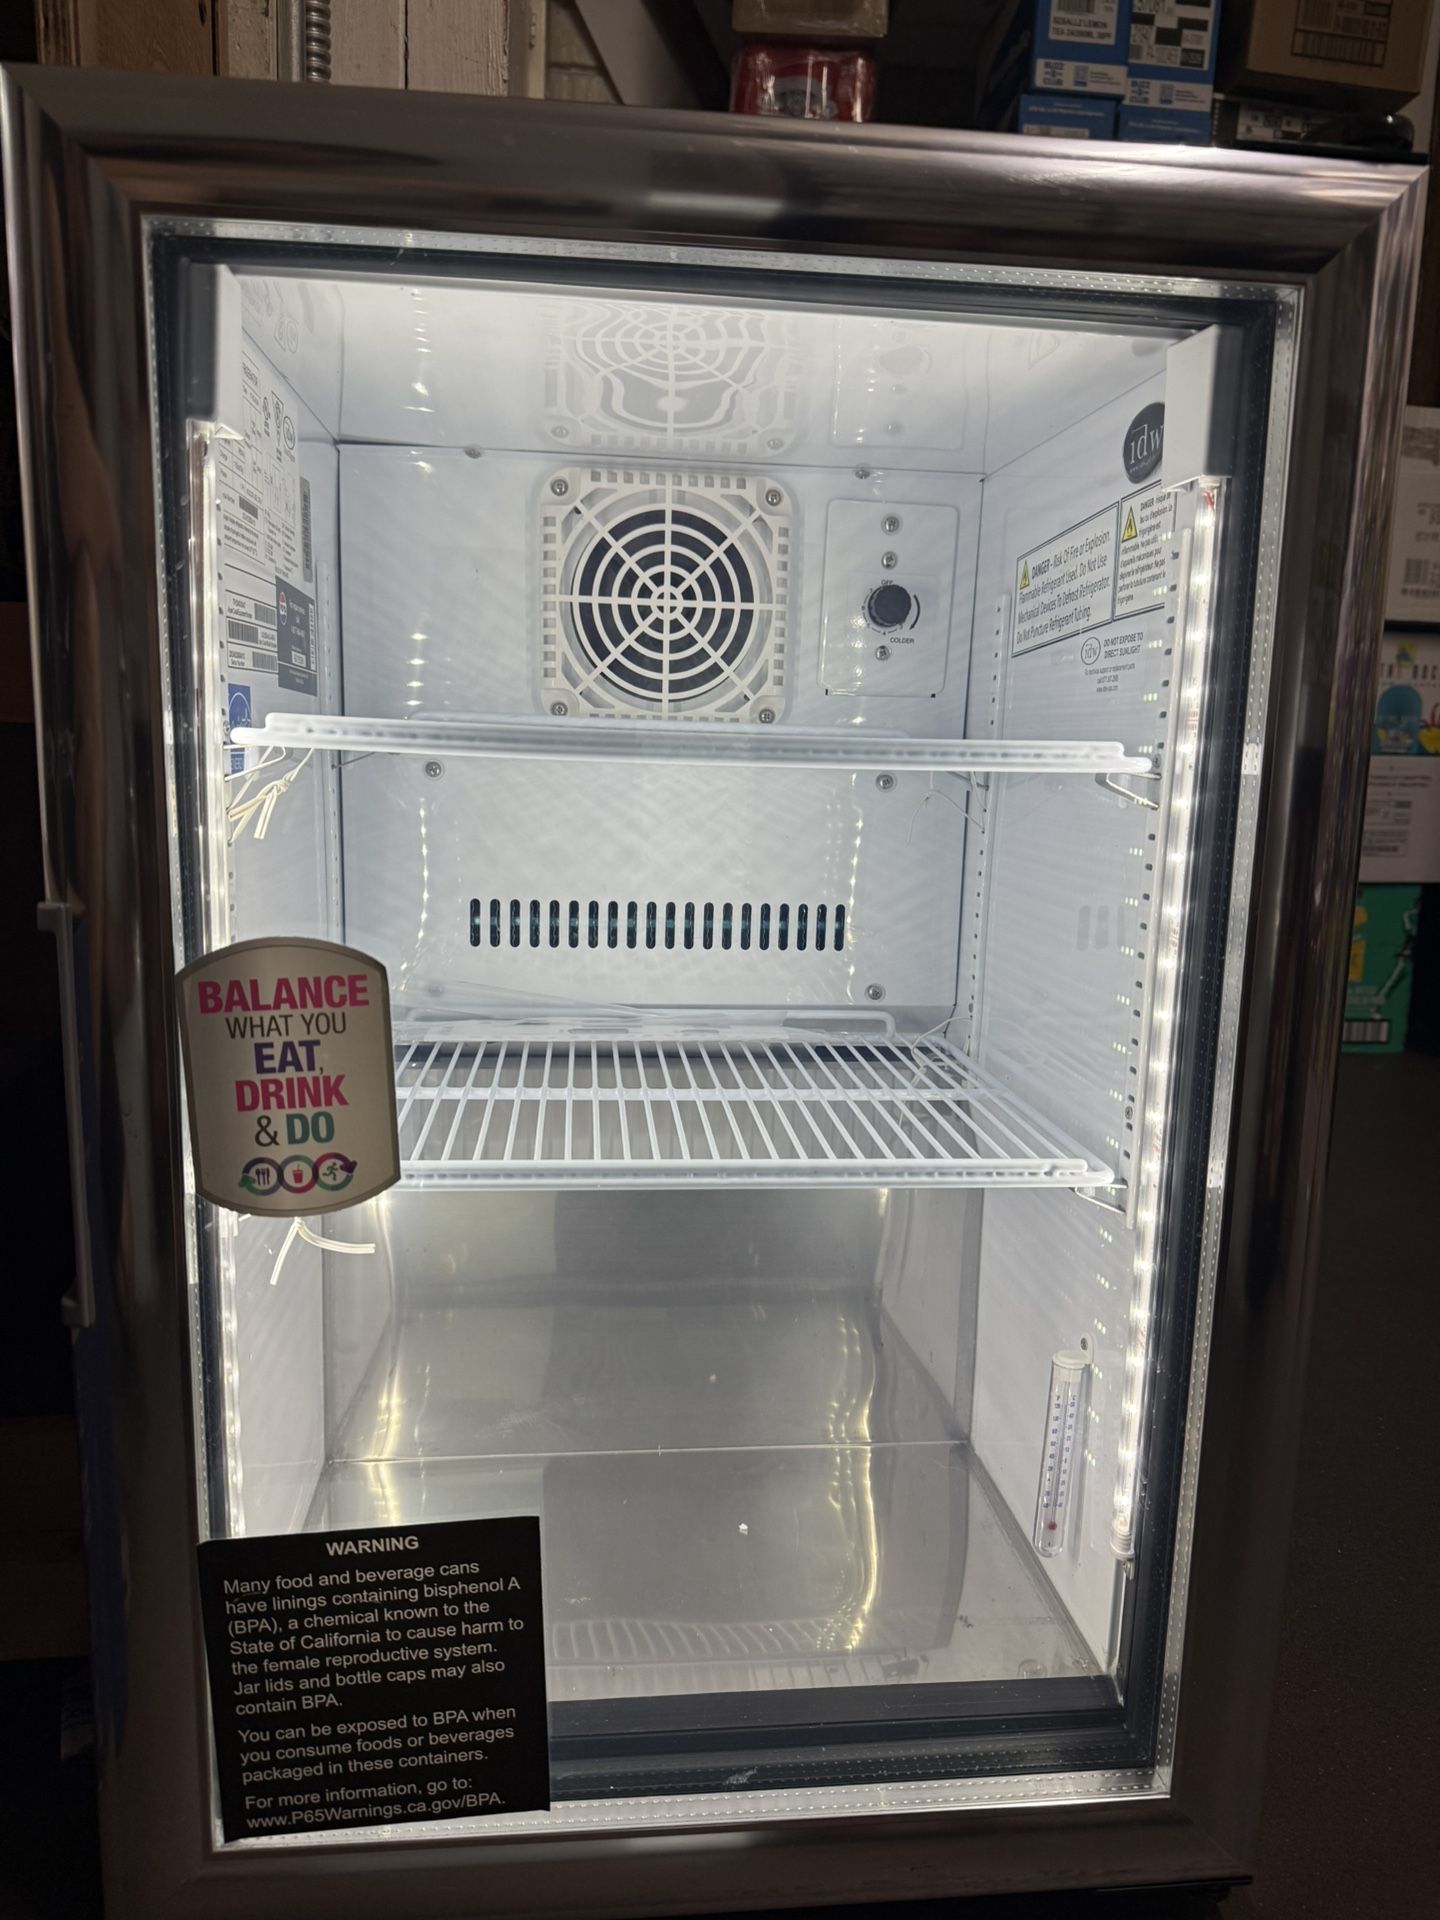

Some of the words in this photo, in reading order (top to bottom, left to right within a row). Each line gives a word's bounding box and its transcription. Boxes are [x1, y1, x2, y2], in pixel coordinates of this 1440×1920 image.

[1032, 558, 1050, 579] DANGER
[1053, 552, 1062, 568] Risk
[1070, 545, 1078, 561] Fire
[1041, 573, 1065, 595] Refrigerant
[1088, 557, 1096, 572] Not
[1097, 554, 1108, 569] Use
[1018, 607, 1039, 624] Mechanical
[1040, 599, 1056, 615] Devices
[1063, 587, 1079, 606] Defrost
[1031, 621, 1048, 638] Puncture
[1049, 612, 1074, 632] Refrigerant
[1120, 633, 1136, 645] EXPOSE
[1104, 648, 1119, 659] DIRECT
[1120, 644, 1141, 656] SUNLIGHT
[198, 974, 369, 1014] BALANCE
[225, 1014, 293, 1039] WHAT
[300, 1012, 346, 1036] YOU
[254, 1039, 324, 1075] EAT,
[235, 1074, 349, 1112] DRINK
[254, 1115, 280, 1147] &
[286, 1111, 334, 1145] DO
[325, 1535, 420, 1557] WARNING
[223, 1579, 271, 1595] Many
[275, 1573, 313, 1590] food
[318, 1570, 351, 1587] and
[355, 1566, 435, 1583] beverage
[439, 1562, 480, 1576] cans
[225, 1599, 268, 1615] have
[272, 1594, 328, 1611] linings
[331, 1586, 419, 1606] containing
[423, 1577, 504, 1599] bisphenol
[507, 1576, 521, 1591] A
[228, 1617, 283, 1638] (BPA),
[287, 1618, 299, 1630] a
[303, 1608, 379, 1629] chemical
[383, 1606, 439, 1622] known
[442, 1603, 460, 1617] to
[463, 1600, 490, 1615] the
[230, 1639, 274, 1655] State
[279, 1635, 296, 1651] of
[300, 1629, 381, 1650] California
[385, 1628, 402, 1642] to
[406, 1625, 457, 1640] cause
[461, 1621, 504, 1636] harm
[507, 1617, 524, 1631] to
[231, 1661, 258, 1676] the
[262, 1655, 321, 1673] female
[325, 1646, 429, 1669] reproductive
[433, 1642, 497, 1662] system.
[233, 1681, 261, 1696] Jar
[265, 1677, 294, 1693] lids
[299, 1673, 331, 1690] and
[335, 1669, 382, 1686] bottle
[386, 1669, 427, 1684] caps
[431, 1664, 467, 1679] may
[471, 1659, 506, 1674] also
[235, 1697, 297, 1716] contain
[301, 1693, 343, 1710] BPA.
[238, 1729, 270, 1743] You
[275, 1727, 306, 1740] can
[310, 1723, 332, 1737] be
[336, 1714, 408, 1736] exposed
[412, 1714, 428, 1728] to
[432, 1709, 470, 1726] BPA
[471, 1707, 516, 1722] when
[240, 1751, 271, 1767] you
[275, 1742, 352, 1760] consume
[356, 1736, 403, 1752] foods
[407, 1735, 425, 1748] or
[428, 1727, 515, 1745] beverages
[242, 1762, 324, 1786] packaged
[328, 1761, 343, 1774] in
[348, 1758, 394, 1773] these
[398, 1749, 488, 1768] containers.
[245, 1796, 273, 1809] For
[278, 1793, 321, 1806] more
[325, 1782, 422, 1802] information,
[426, 1780, 448, 1796] go
[452, 1777, 472, 1790] to:
[246, 1791, 506, 1828] www.P65Warnings.ca.gov/BPA.
